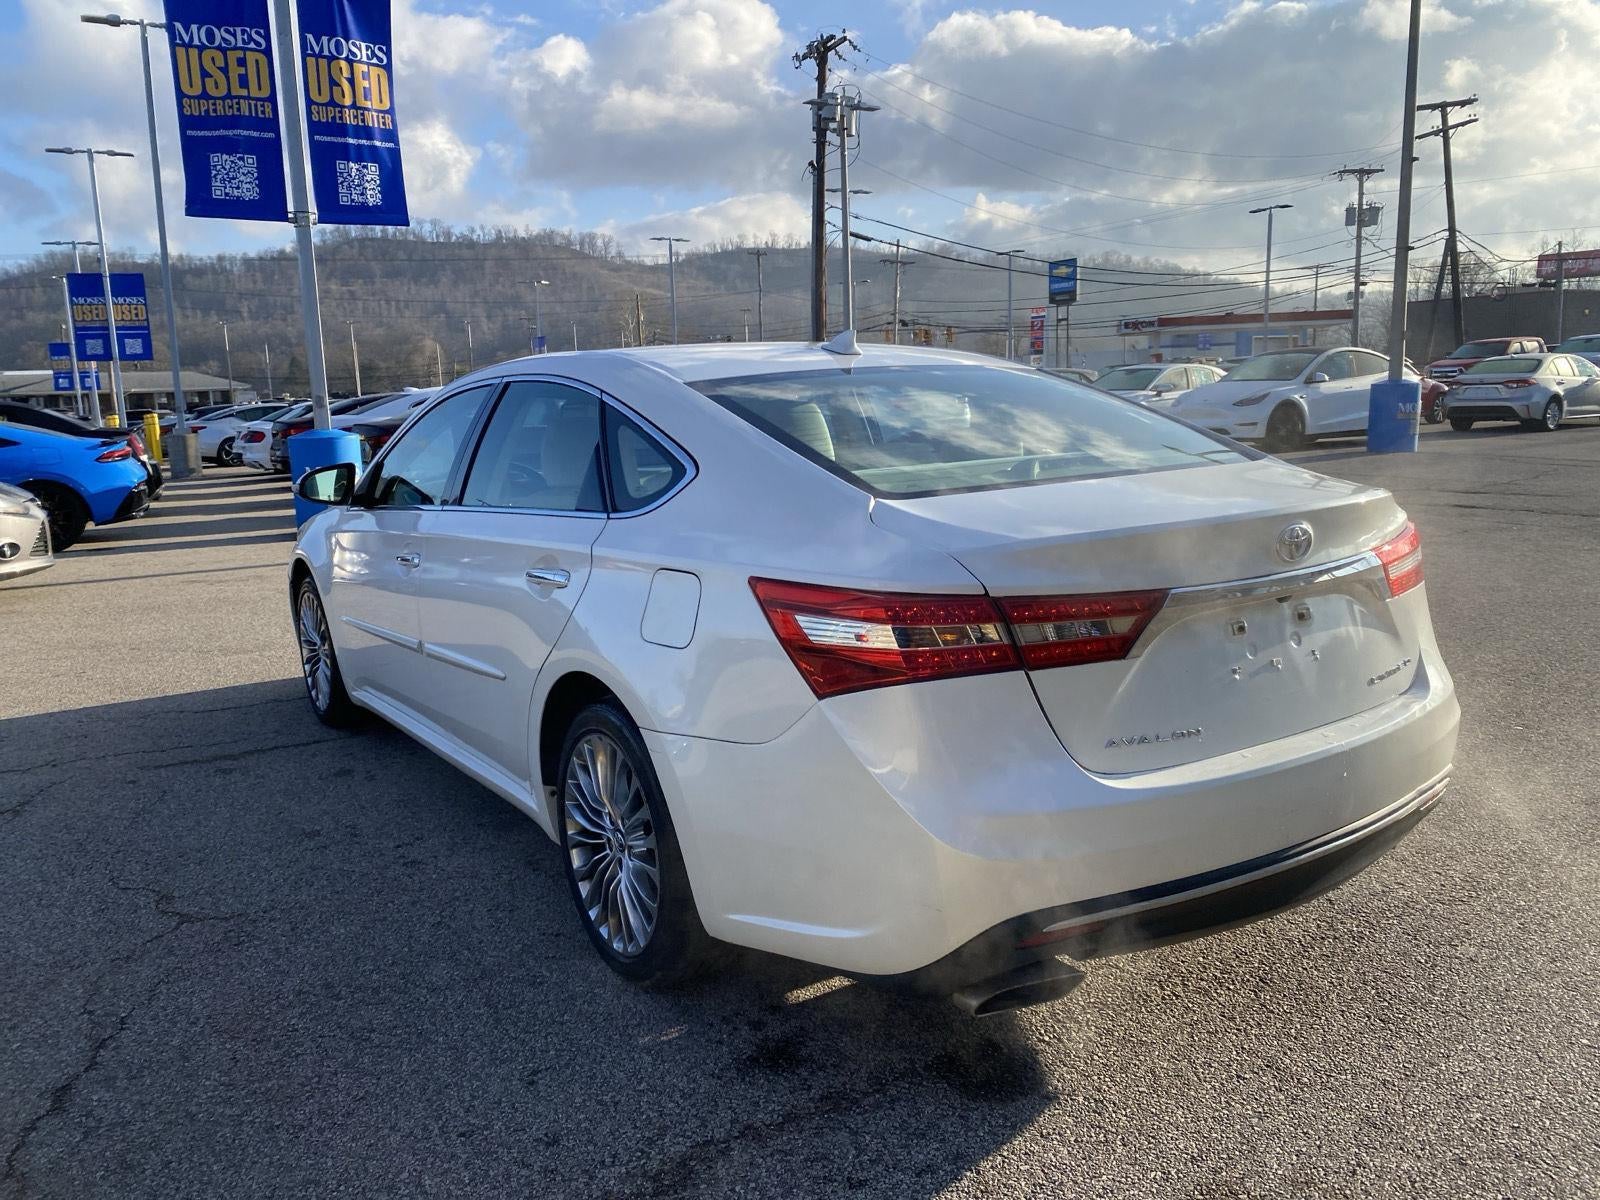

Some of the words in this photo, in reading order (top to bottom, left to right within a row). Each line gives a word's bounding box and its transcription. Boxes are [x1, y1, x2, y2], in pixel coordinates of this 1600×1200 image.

[173, 21, 266, 50] MOSES
[304, 33, 388, 65] MOSES
[175, 46, 271, 98] USED
[306, 56, 391, 111] USED
[182, 98, 273, 119] SUPERCENTER
[311, 104, 393, 130] SUPERCENTER
[186, 129, 275, 139] mosesusedsupercenter.com
[313, 135, 395, 148] mosesusedsupercenter.com
[72, 296, 106, 304] MOSES
[112, 296, 145, 304] MOSES
[73, 304, 108, 321] USED
[113, 304, 147, 320] USED
[1104, 727, 1203, 749] AVALON
